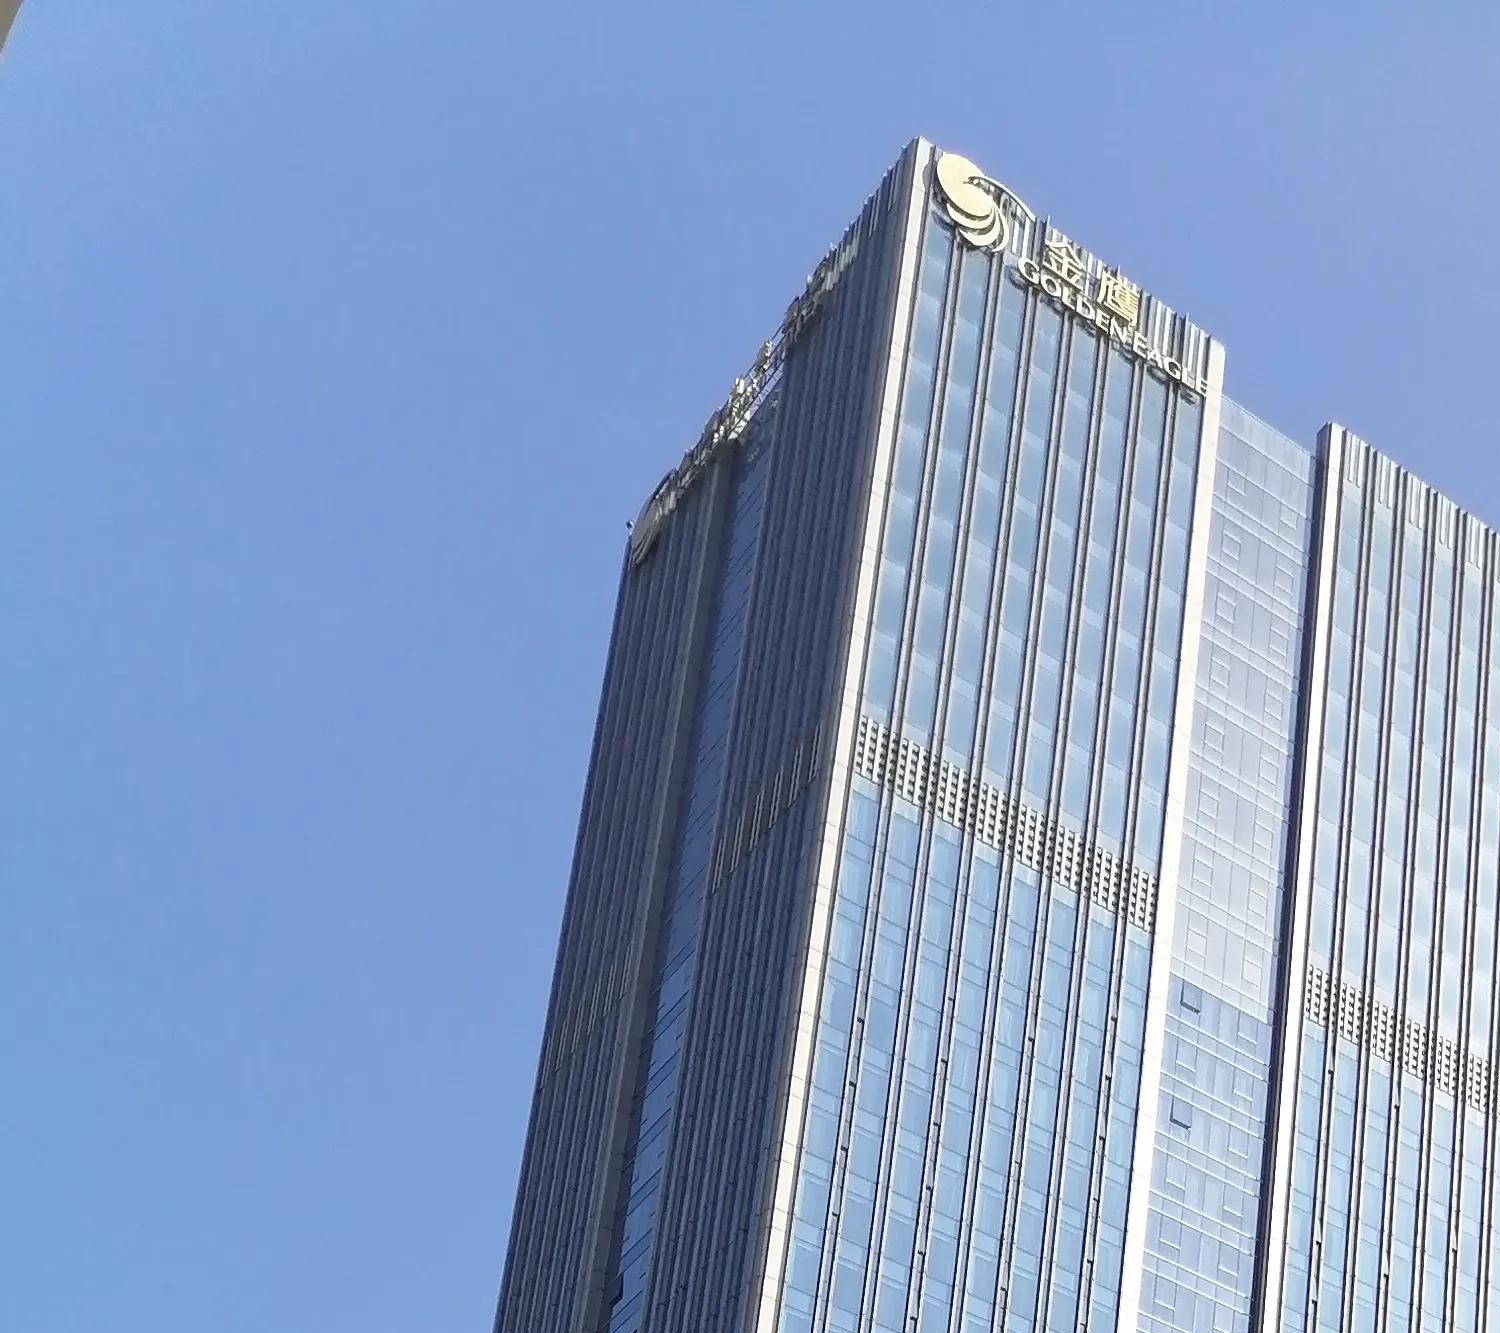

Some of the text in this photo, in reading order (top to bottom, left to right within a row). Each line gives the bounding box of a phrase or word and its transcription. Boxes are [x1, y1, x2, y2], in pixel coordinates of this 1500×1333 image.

[1017, 256, 1209, 399] GOLDEN EAGLE
[1042, 237, 1141, 328] 金鹰
